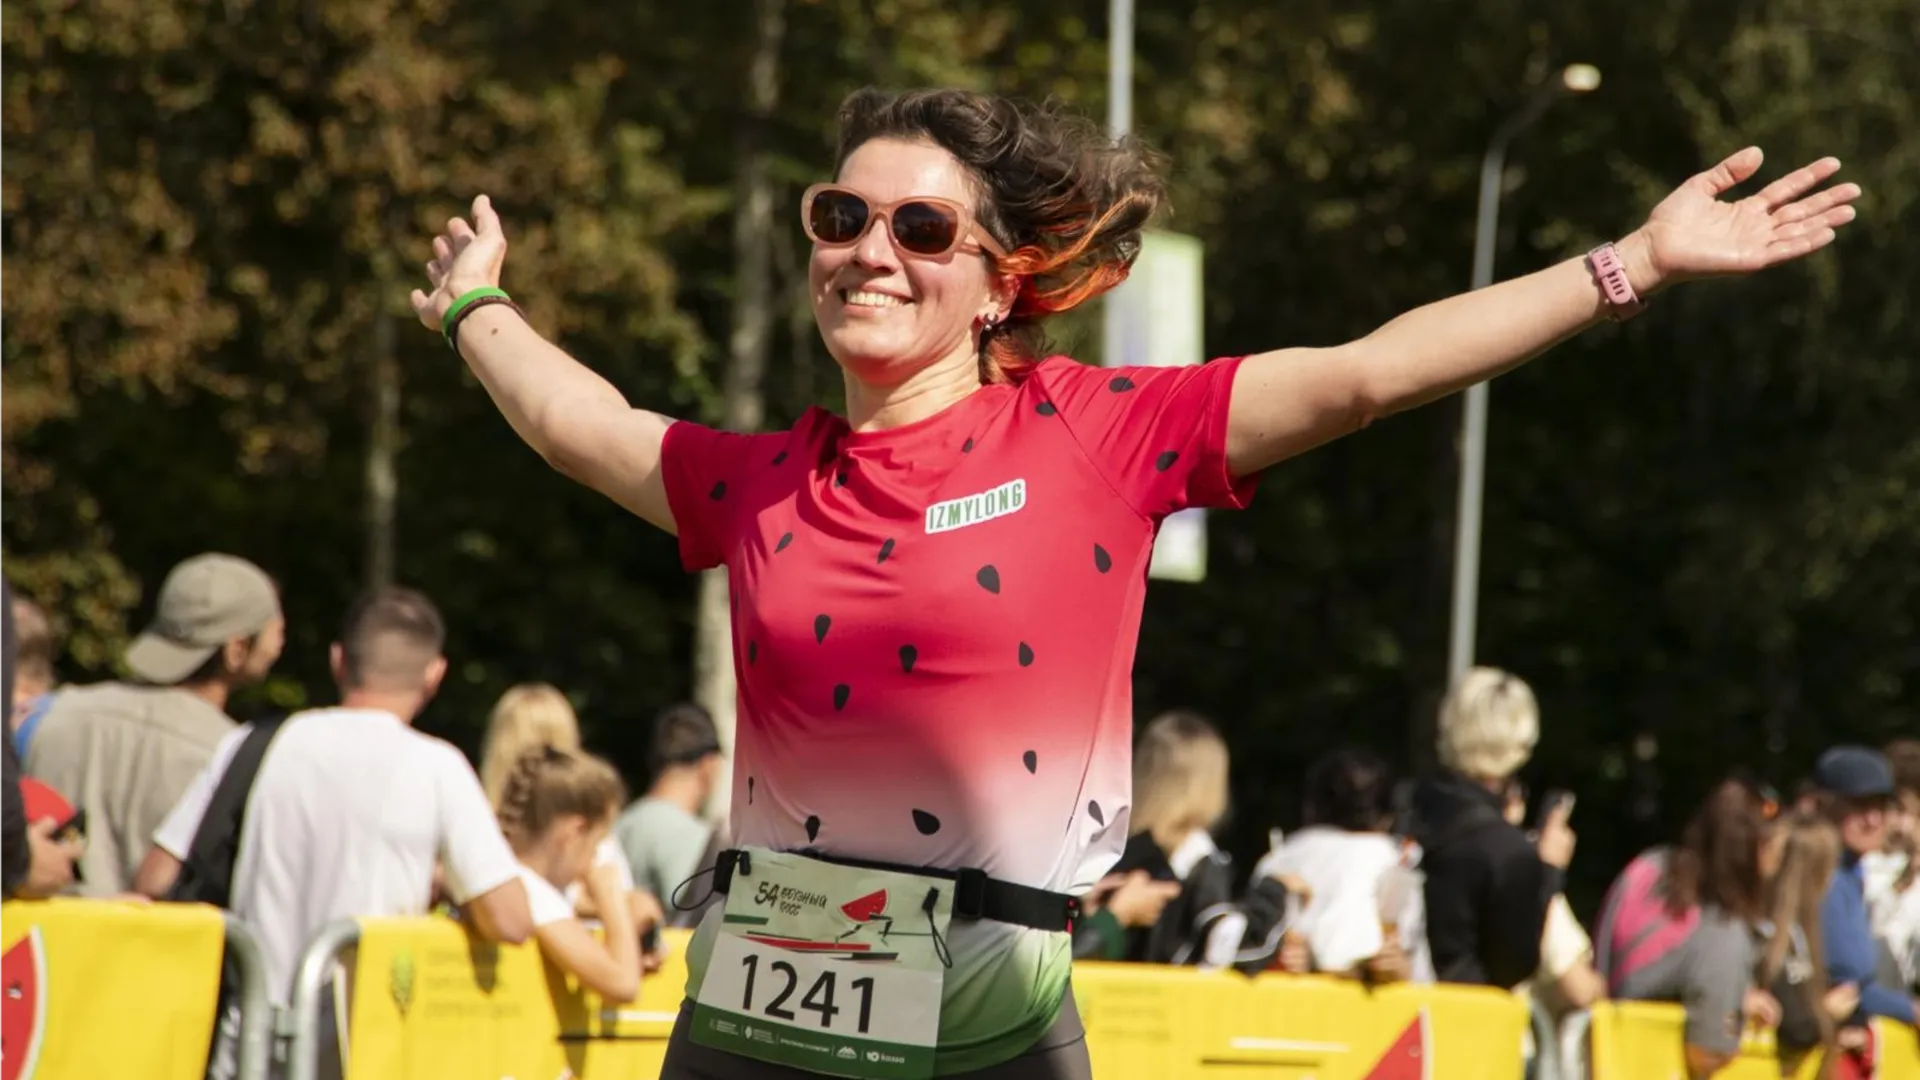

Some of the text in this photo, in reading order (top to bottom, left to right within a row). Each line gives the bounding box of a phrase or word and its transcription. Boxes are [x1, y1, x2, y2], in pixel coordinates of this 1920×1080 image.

[929, 483, 1022, 530] IZMYLONG
[754, 881, 780, 909] 54
[742, 954, 875, 1034] 1241
